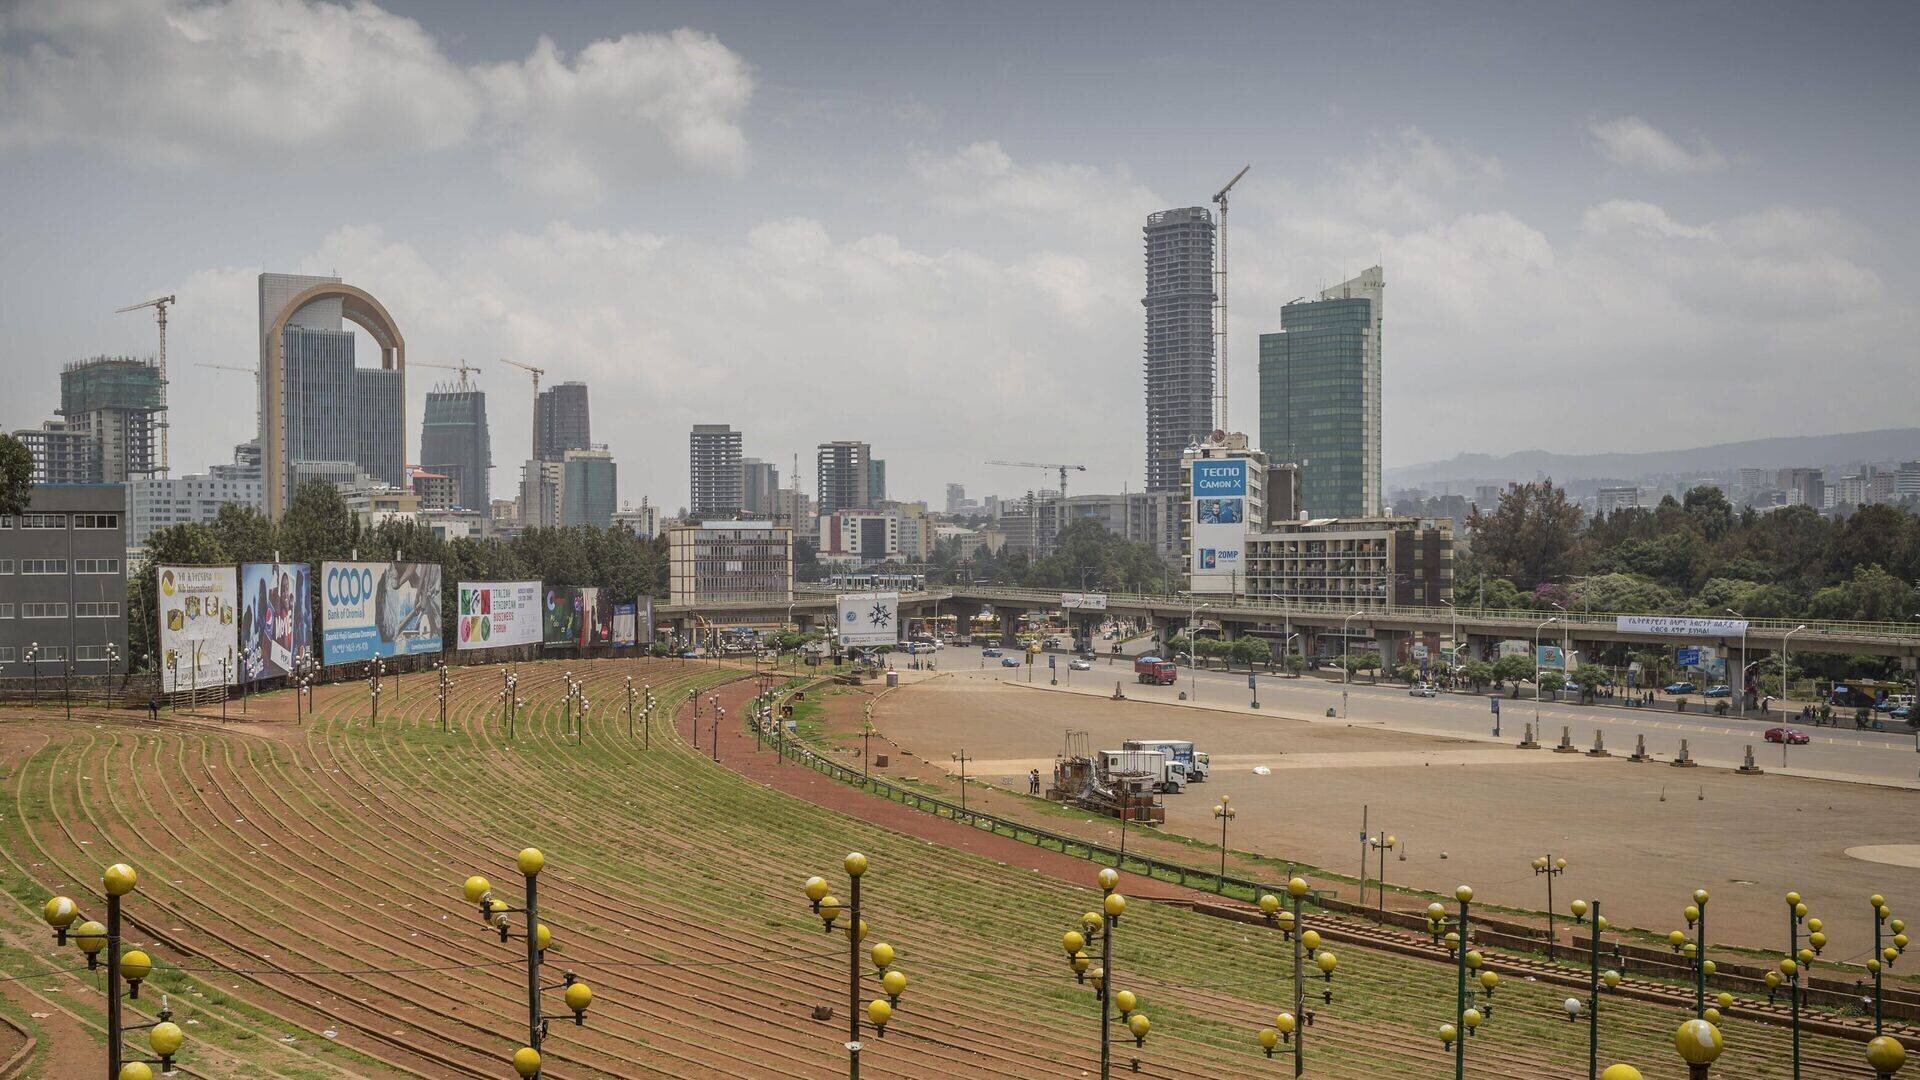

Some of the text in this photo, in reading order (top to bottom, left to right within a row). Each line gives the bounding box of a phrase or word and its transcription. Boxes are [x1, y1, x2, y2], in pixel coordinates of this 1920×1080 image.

[1202, 467, 1240, 477] TECNO
[1233, 479, 1241, 488] X
[1217, 550, 1239, 559] 20MP
[493, 589, 511, 598] ITALIAN
[328, 608, 340, 620] Bank
[340, 608, 346, 619] of
[493, 612, 514, 621] BUSINESS
[493, 624, 506, 633] FORUM
